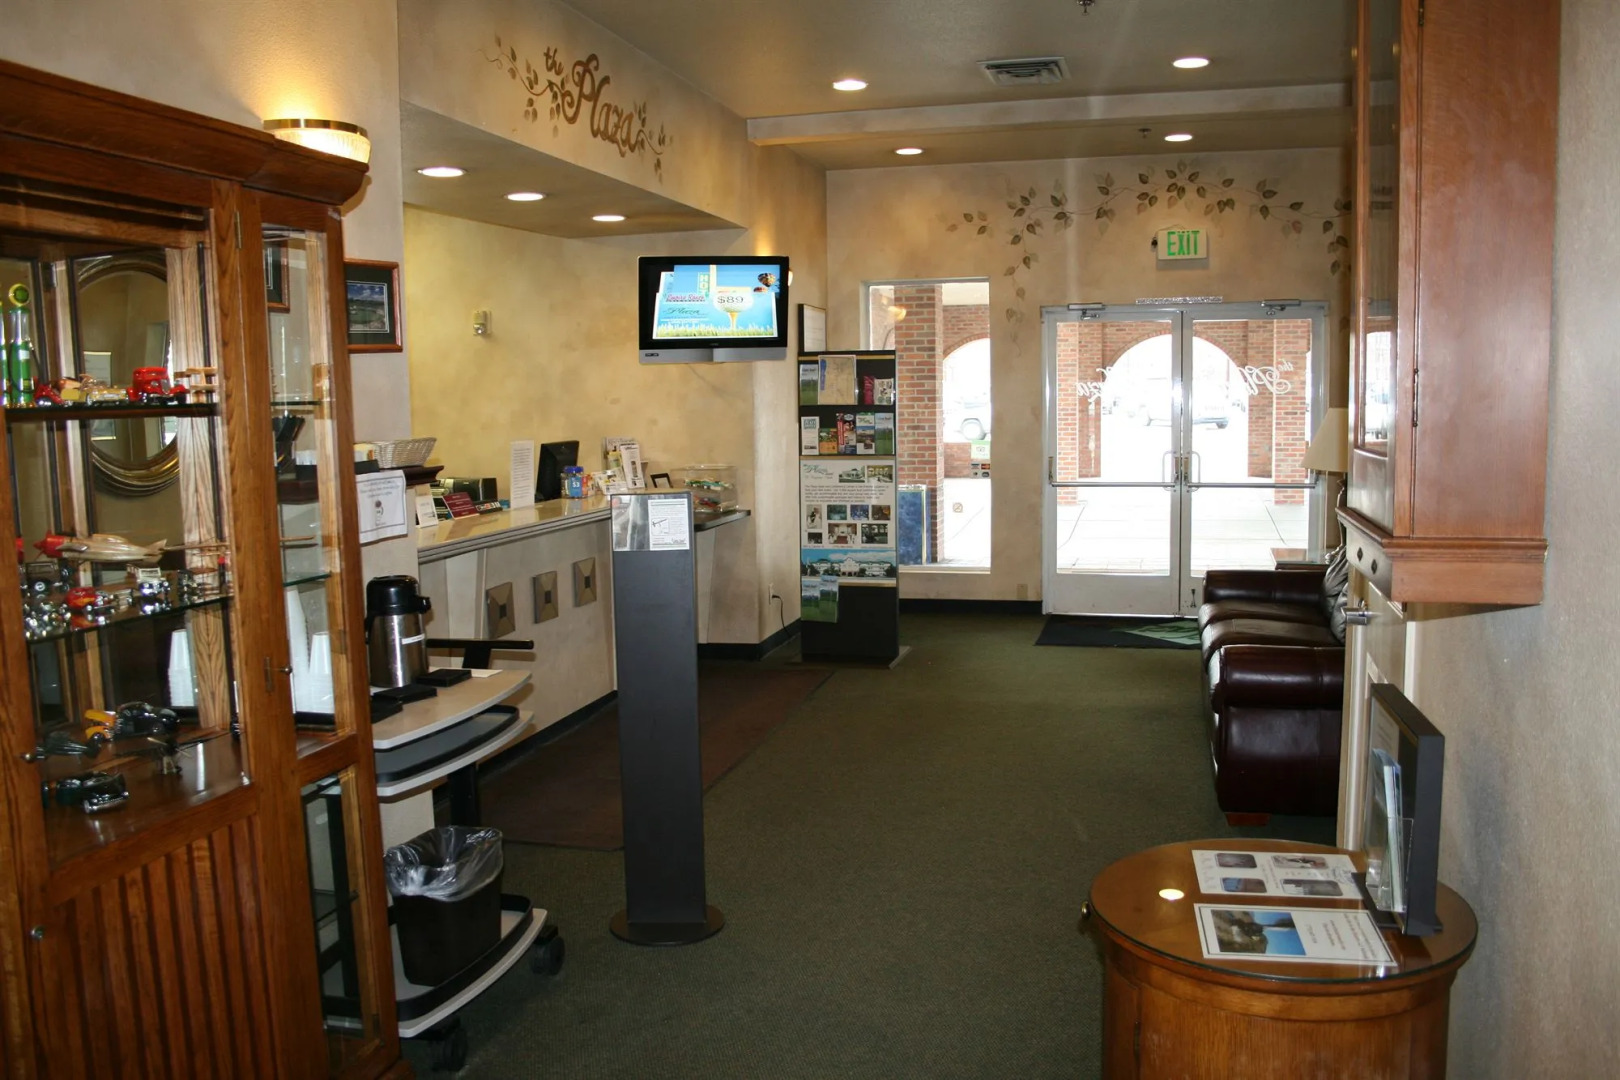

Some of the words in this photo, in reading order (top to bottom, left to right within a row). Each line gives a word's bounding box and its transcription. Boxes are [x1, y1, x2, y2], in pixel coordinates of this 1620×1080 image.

[543, 46, 564, 76] the
[560, 53, 637, 158] Plaza
[1166, 230, 1200, 257] EXIT
[717, 295, 744, 304] $89
